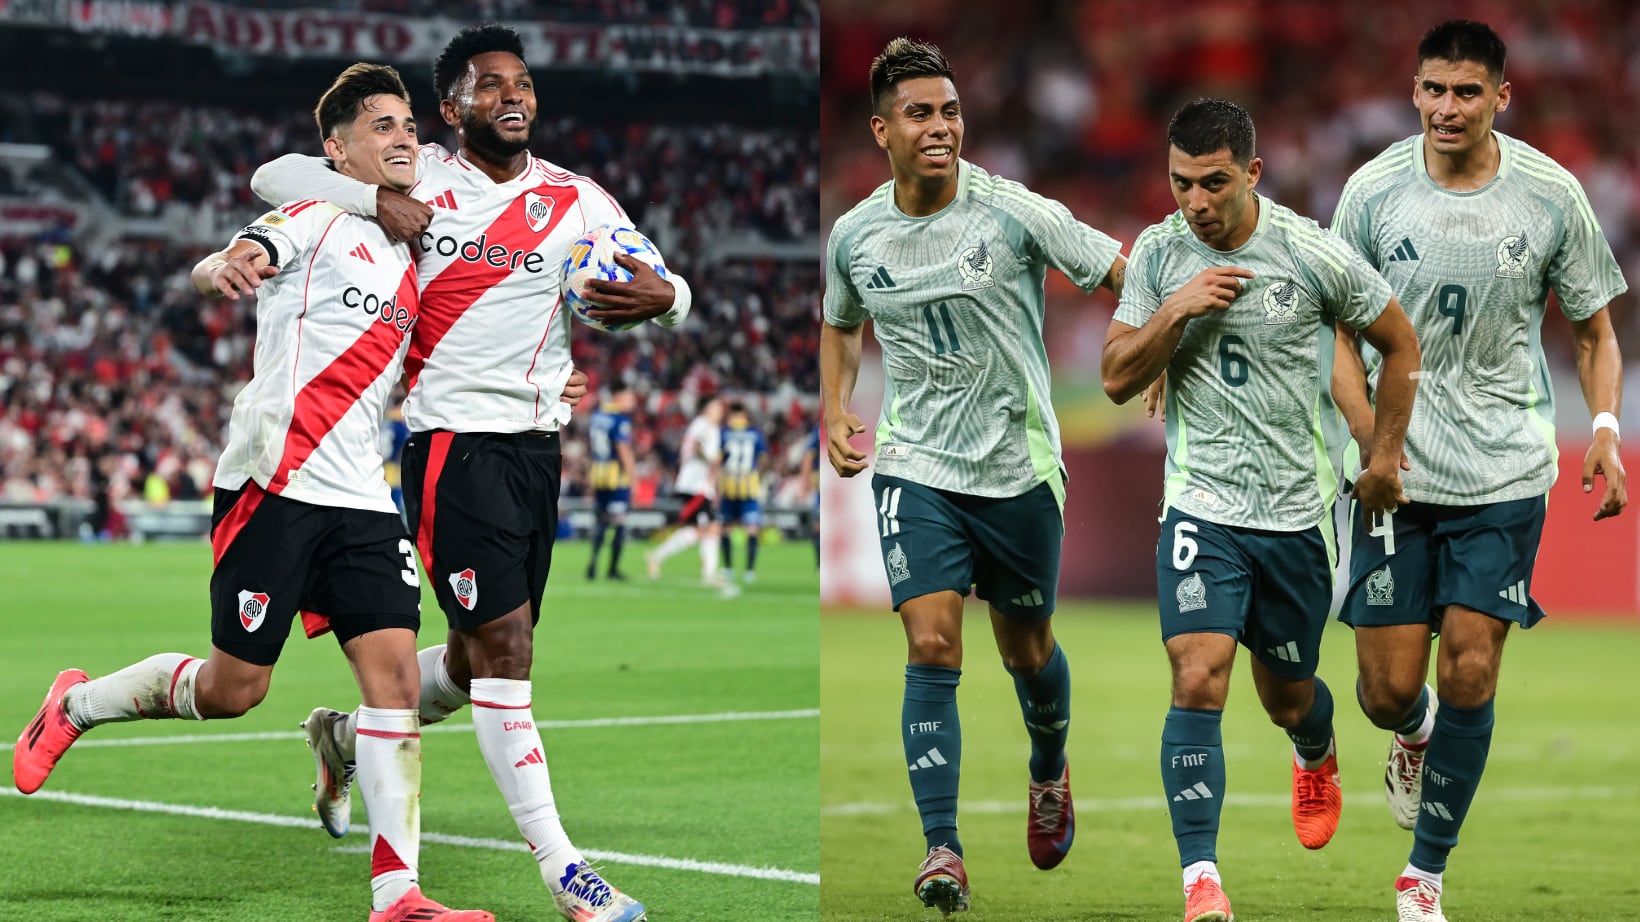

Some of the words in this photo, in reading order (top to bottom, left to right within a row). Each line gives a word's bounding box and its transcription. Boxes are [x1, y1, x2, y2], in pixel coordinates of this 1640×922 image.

[187, 4, 413, 54] ADICTO
[420, 231, 545, 274] codere
[342, 286, 418, 333] coder
[923, 301, 961, 355] 11
[1438, 284, 1467, 336] 9
[1219, 334, 1249, 388] 6
[879, 486, 902, 537] 11
[1172, 521, 1199, 571] 6
[503, 721, 532, 731] CARP
[909, 720, 943, 735] FMF
[1171, 753, 1208, 769] FMF
[1424, 764, 1454, 788] FMF
